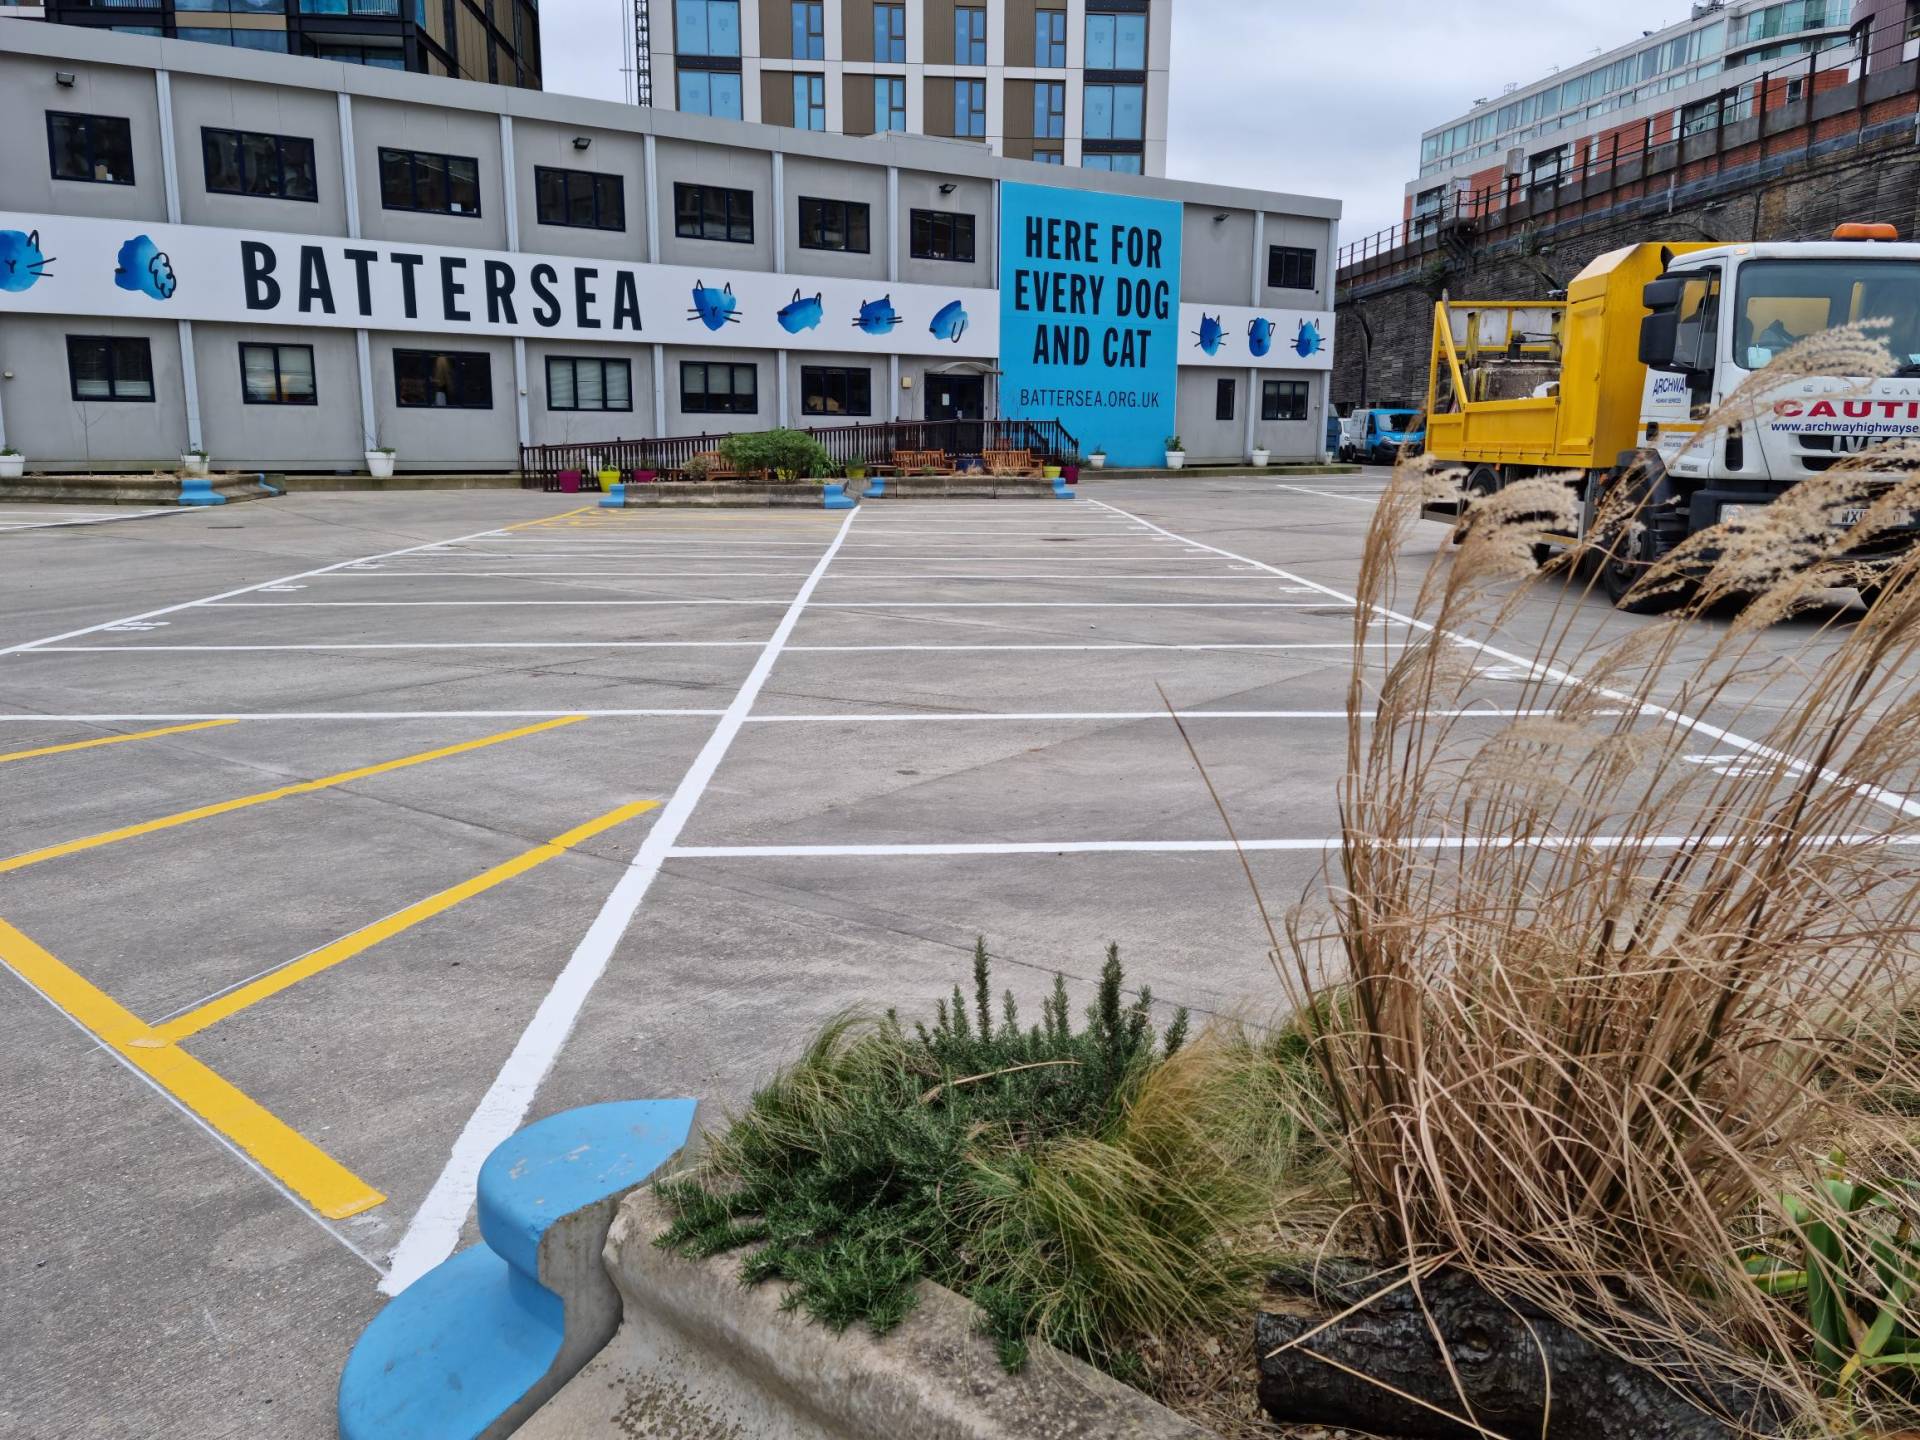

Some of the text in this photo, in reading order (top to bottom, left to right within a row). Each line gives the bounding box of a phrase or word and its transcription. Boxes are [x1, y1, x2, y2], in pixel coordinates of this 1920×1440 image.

[1025, 216, 1162, 269] HERE FOR
[240, 239, 643, 332] BATTERSEA
[1014, 269, 1169, 320] EVERY DOG
[1032, 324, 1152, 368] AND CAT
[1020, 388, 1160, 408] BATTERSEA.ORG.UK
[1652, 377, 1688, 396] ARCHWA
